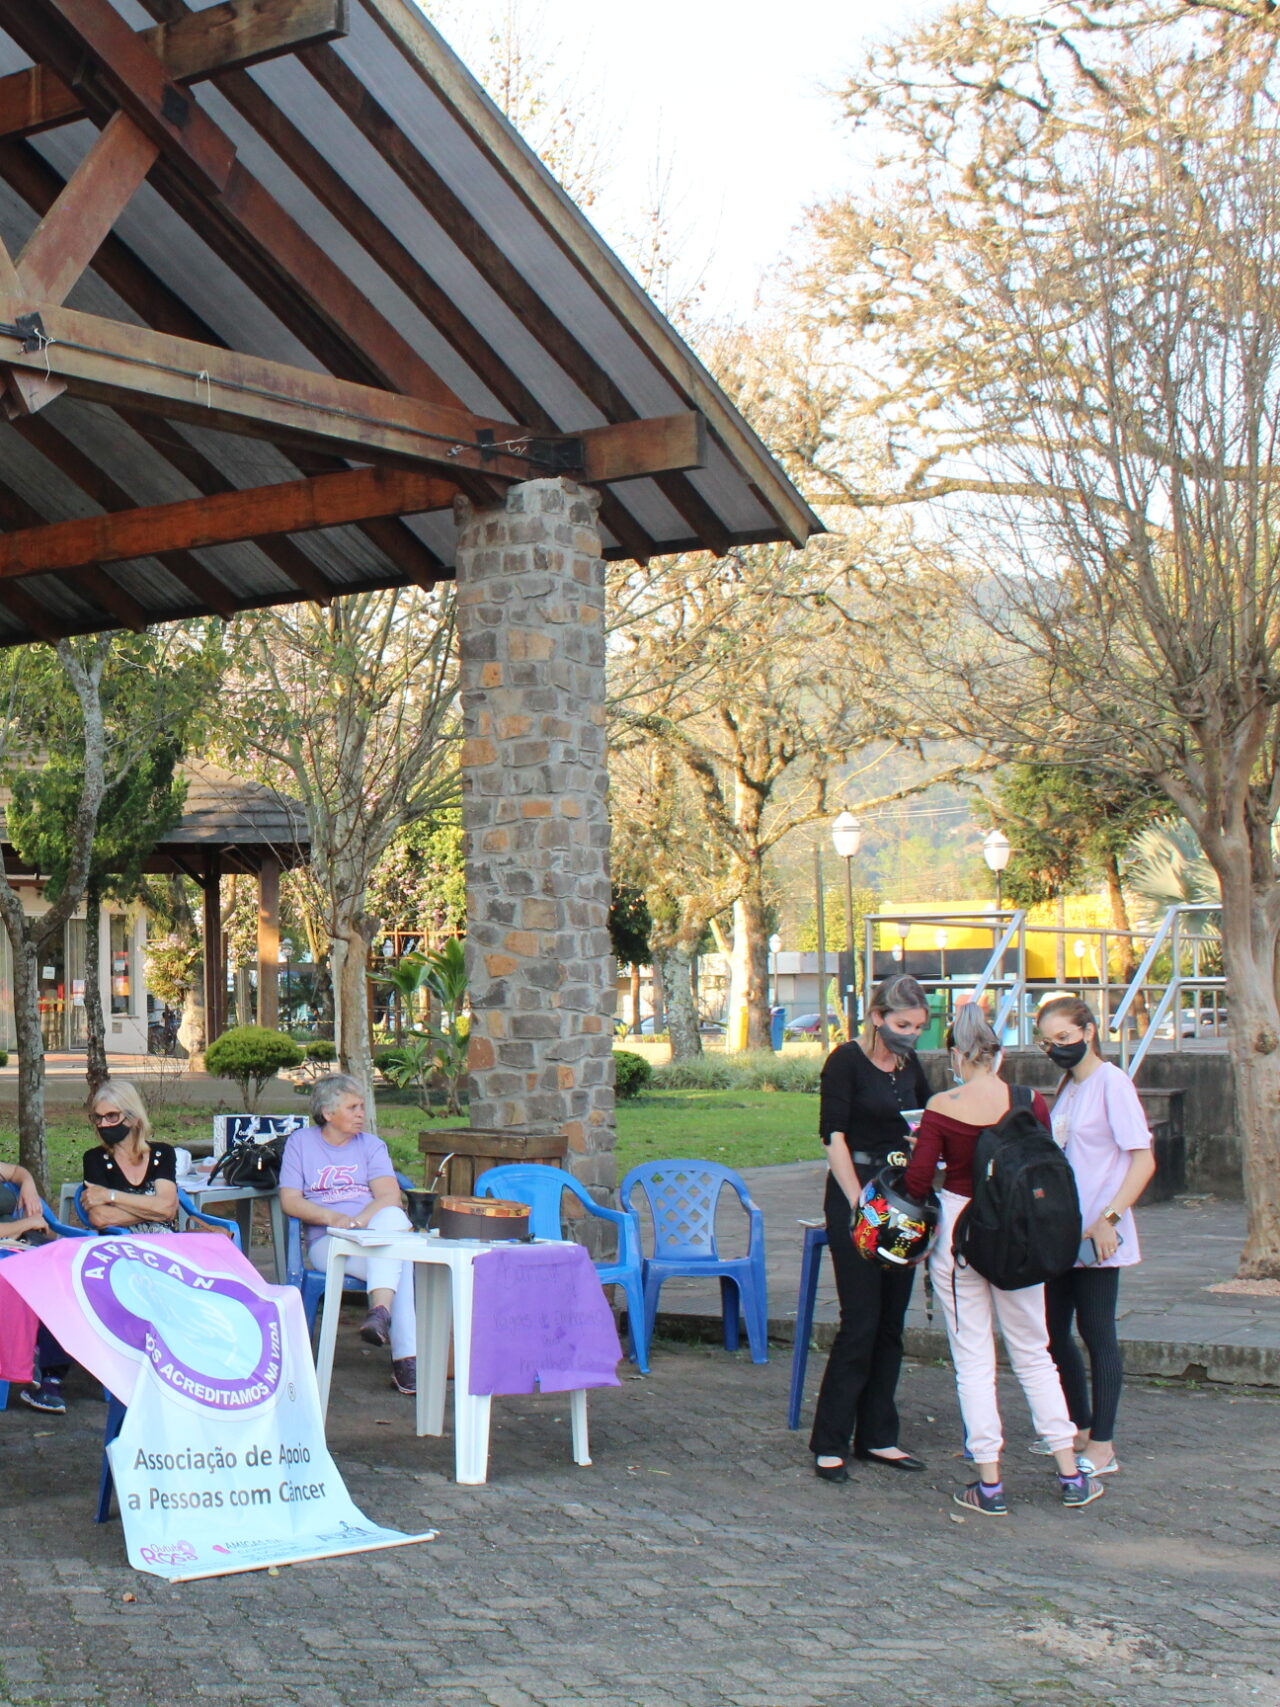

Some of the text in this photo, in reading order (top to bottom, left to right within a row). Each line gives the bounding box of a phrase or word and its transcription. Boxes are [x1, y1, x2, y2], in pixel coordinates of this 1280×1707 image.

[269, 1321, 280, 1358] VIDA
[160, 1363, 270, 1406] ACREDITAMOS
[264, 1362, 280, 1384] NA
[133, 1443, 311, 1473] Associação de Apoio
[127, 1480, 326, 1510] a Pessoas com Câncer
